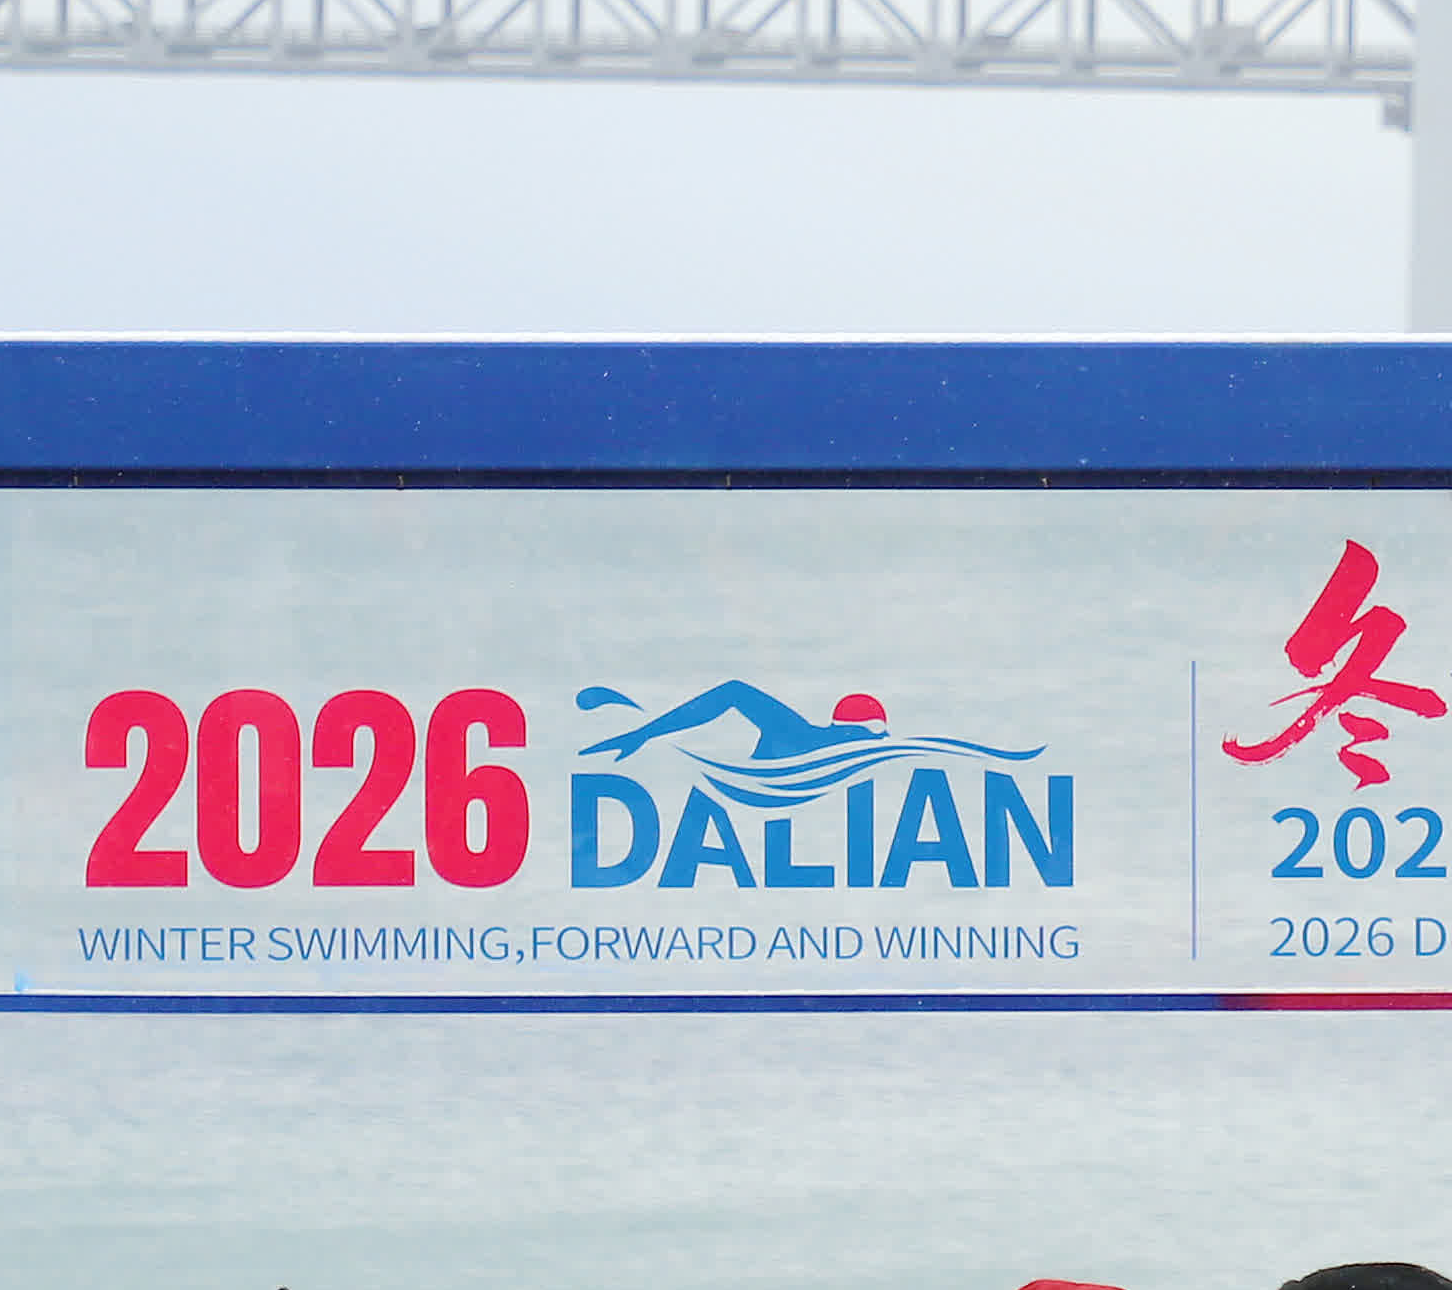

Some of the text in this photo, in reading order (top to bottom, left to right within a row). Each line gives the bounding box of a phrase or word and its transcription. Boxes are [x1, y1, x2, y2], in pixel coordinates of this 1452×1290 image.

[84, 688, 1076, 889] 2026 DALIAN
[77, 926, 256, 962] WINTER
[766, 925, 864, 961] AND
[874, 924, 1081, 961] WINNING
[1267, 915, 1396, 958] 2026
